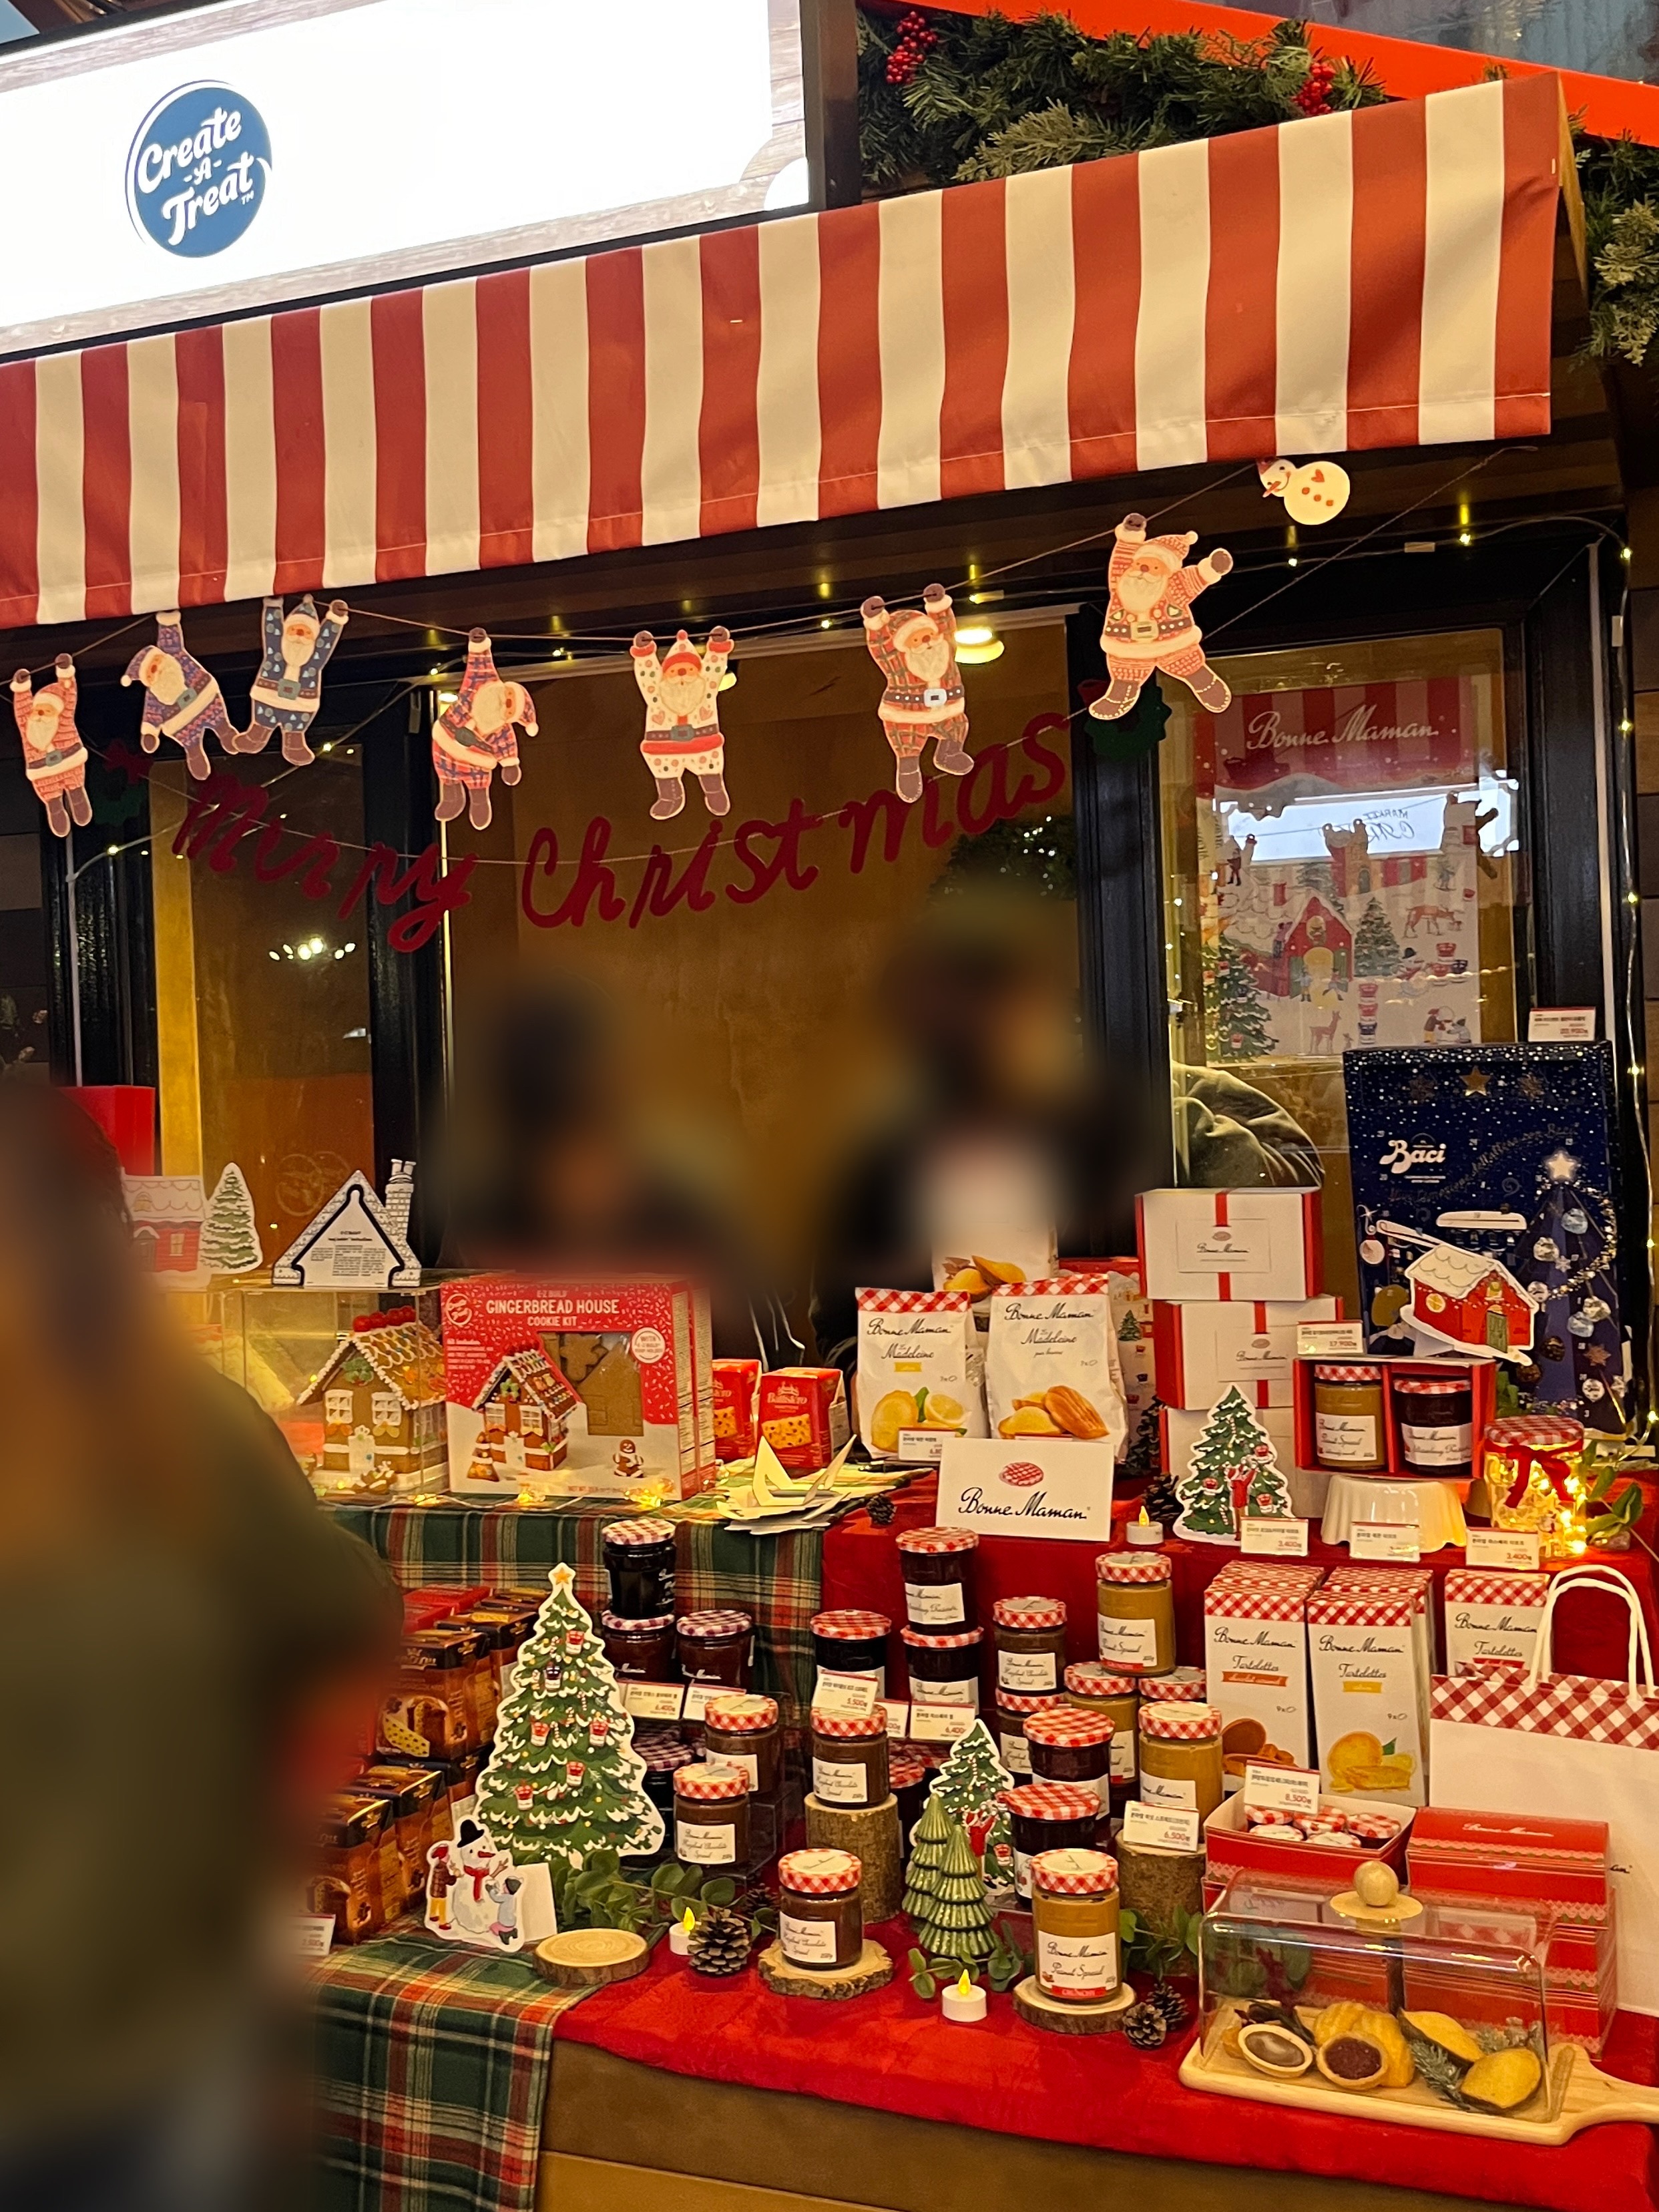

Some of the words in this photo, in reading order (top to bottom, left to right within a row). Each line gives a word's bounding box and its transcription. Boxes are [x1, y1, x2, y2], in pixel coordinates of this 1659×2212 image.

[138, 106, 242, 194] Create
[162, 152, 254, 246] Treat
[1246, 710, 1329, 749] Bonne
[1329, 703, 1439, 742] Maman
[172, 773, 481, 953] Merry
[521, 712, 1066, 929] Christmas
[1379, 1139, 1447, 1174] Baci
[486, 1299, 573, 1314] GINGERBREAD
[576, 1299, 620, 1314] HOUSE
[1005, 1302, 1043, 1320] Bonne
[1044, 1302, 1094, 1319] Maman
[527, 1316, 560, 1327] COOKIE
[562, 1316, 577, 1327] KIT
[867, 1317, 904, 1335] Bonne
[904, 1317, 951, 1335] Maman
[958, 1486, 1013, 1518] Bonne
[1015, 1491, 1088, 1520] Maman
[1454, 1612, 1491, 1630] Bonne
[1491, 1616, 1537, 1633] Maman
[1213, 1626, 1248, 1644] Bonne
[1249, 1630, 1296, 1648] Maman
[1318, 1634, 1355, 1652] Bonne
[1355, 1636, 1405, 1653] Maman
